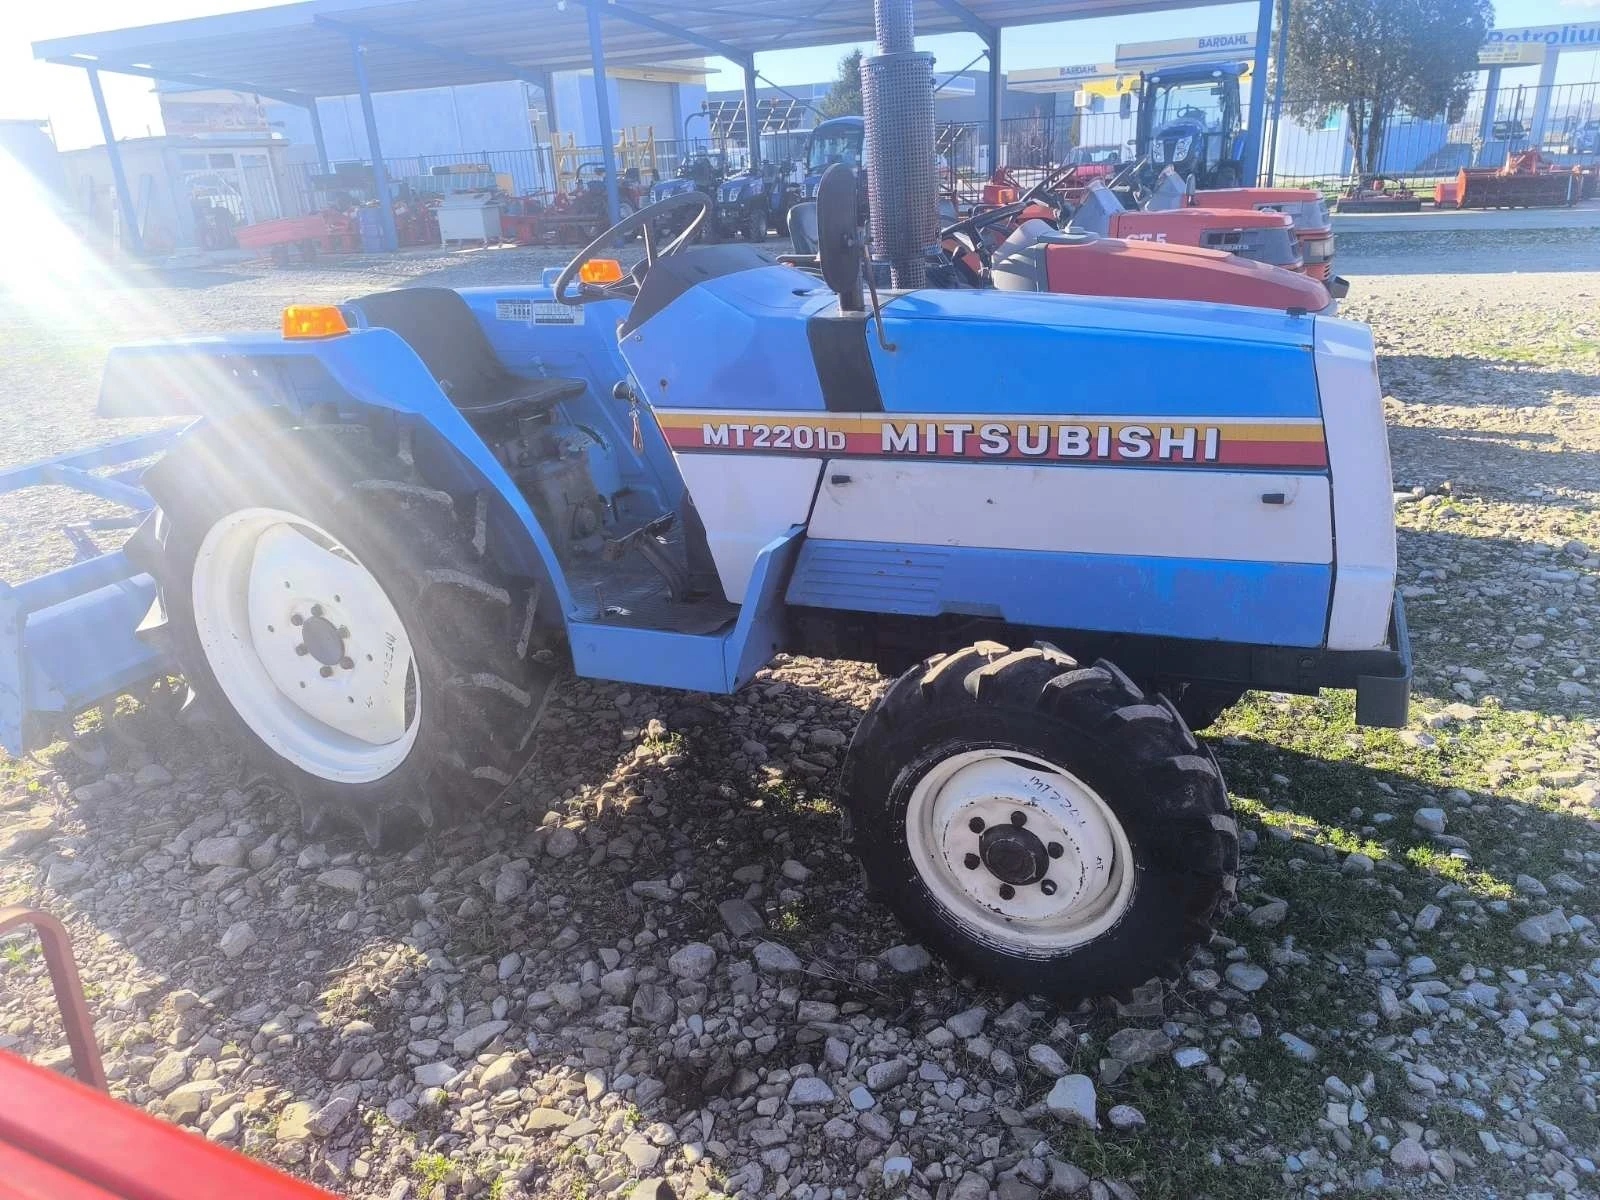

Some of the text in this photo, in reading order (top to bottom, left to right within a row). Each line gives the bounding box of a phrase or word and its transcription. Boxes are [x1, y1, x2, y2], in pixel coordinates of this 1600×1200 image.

[1198, 34, 1249, 49] BARDAHL
[1487, 25, 1600, 45] Petroliu
[1059, 64, 1098, 76] BARDAHL
[702, 423, 1222, 462] MT2201D MITSUBISHI
